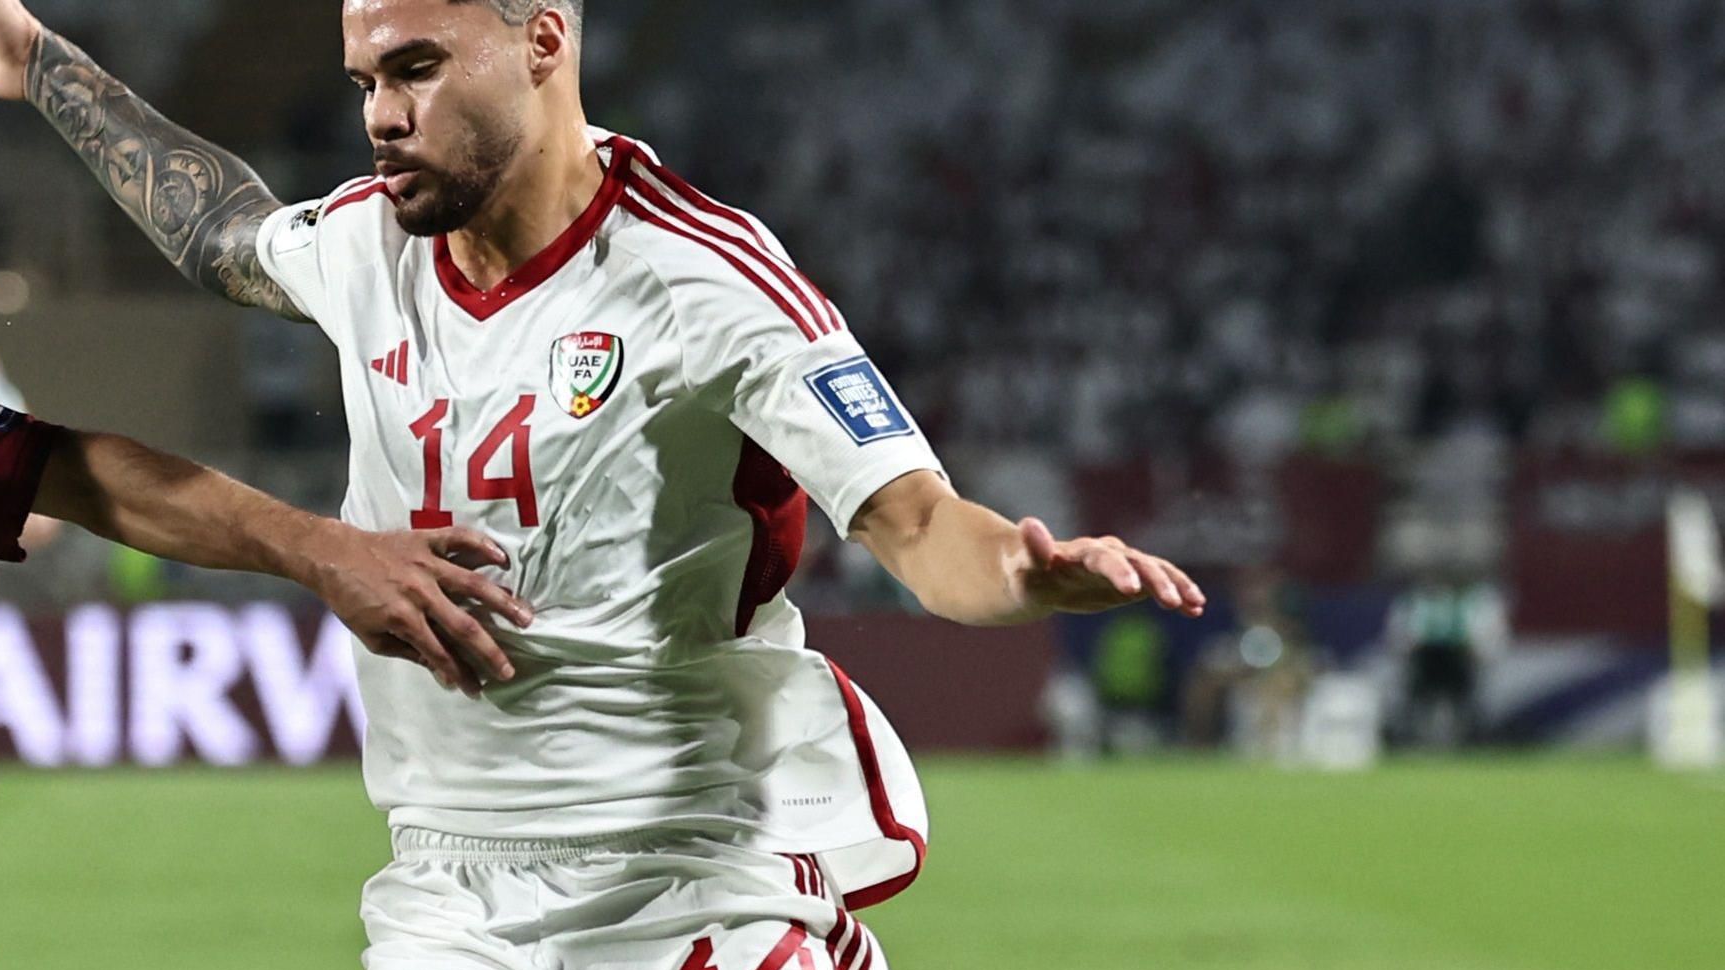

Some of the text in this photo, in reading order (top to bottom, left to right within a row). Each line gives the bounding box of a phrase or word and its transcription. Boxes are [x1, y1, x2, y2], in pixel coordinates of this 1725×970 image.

[568, 355, 602, 367] UAE
[574, 369, 593, 379] FA
[408, 394, 540, 529] 14
